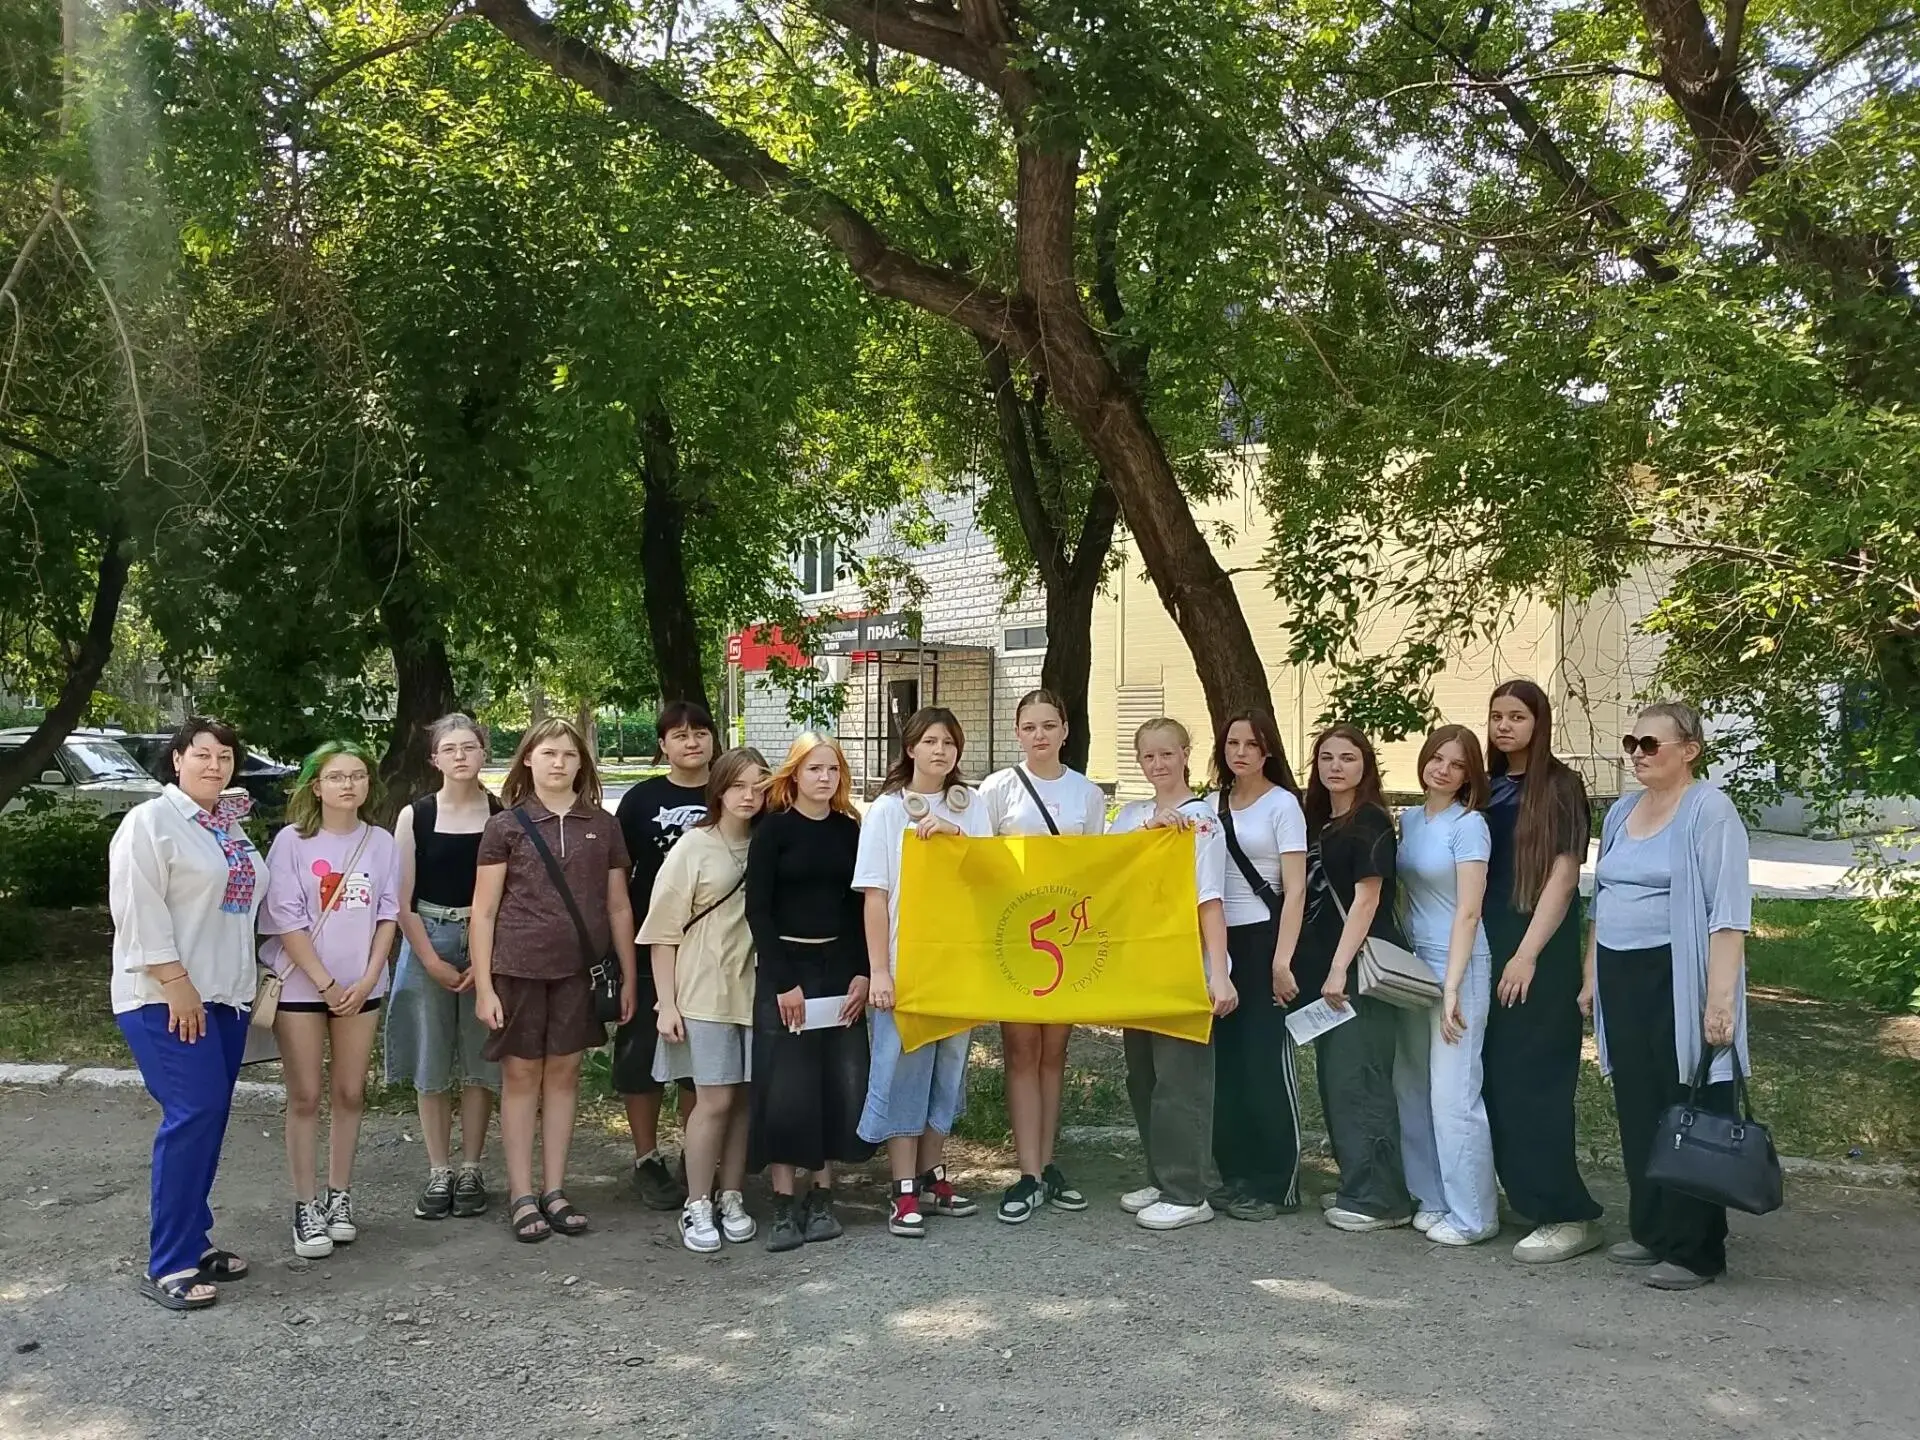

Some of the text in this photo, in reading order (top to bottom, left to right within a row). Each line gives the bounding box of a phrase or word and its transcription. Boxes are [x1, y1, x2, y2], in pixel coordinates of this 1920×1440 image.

[999, 961, 1031, 996] СЛУЖБА
[1018, 886, 1078, 904] НАСЕЛЕНИЯ
[1072, 930, 1109, 993] ТРУДОВАЯ
